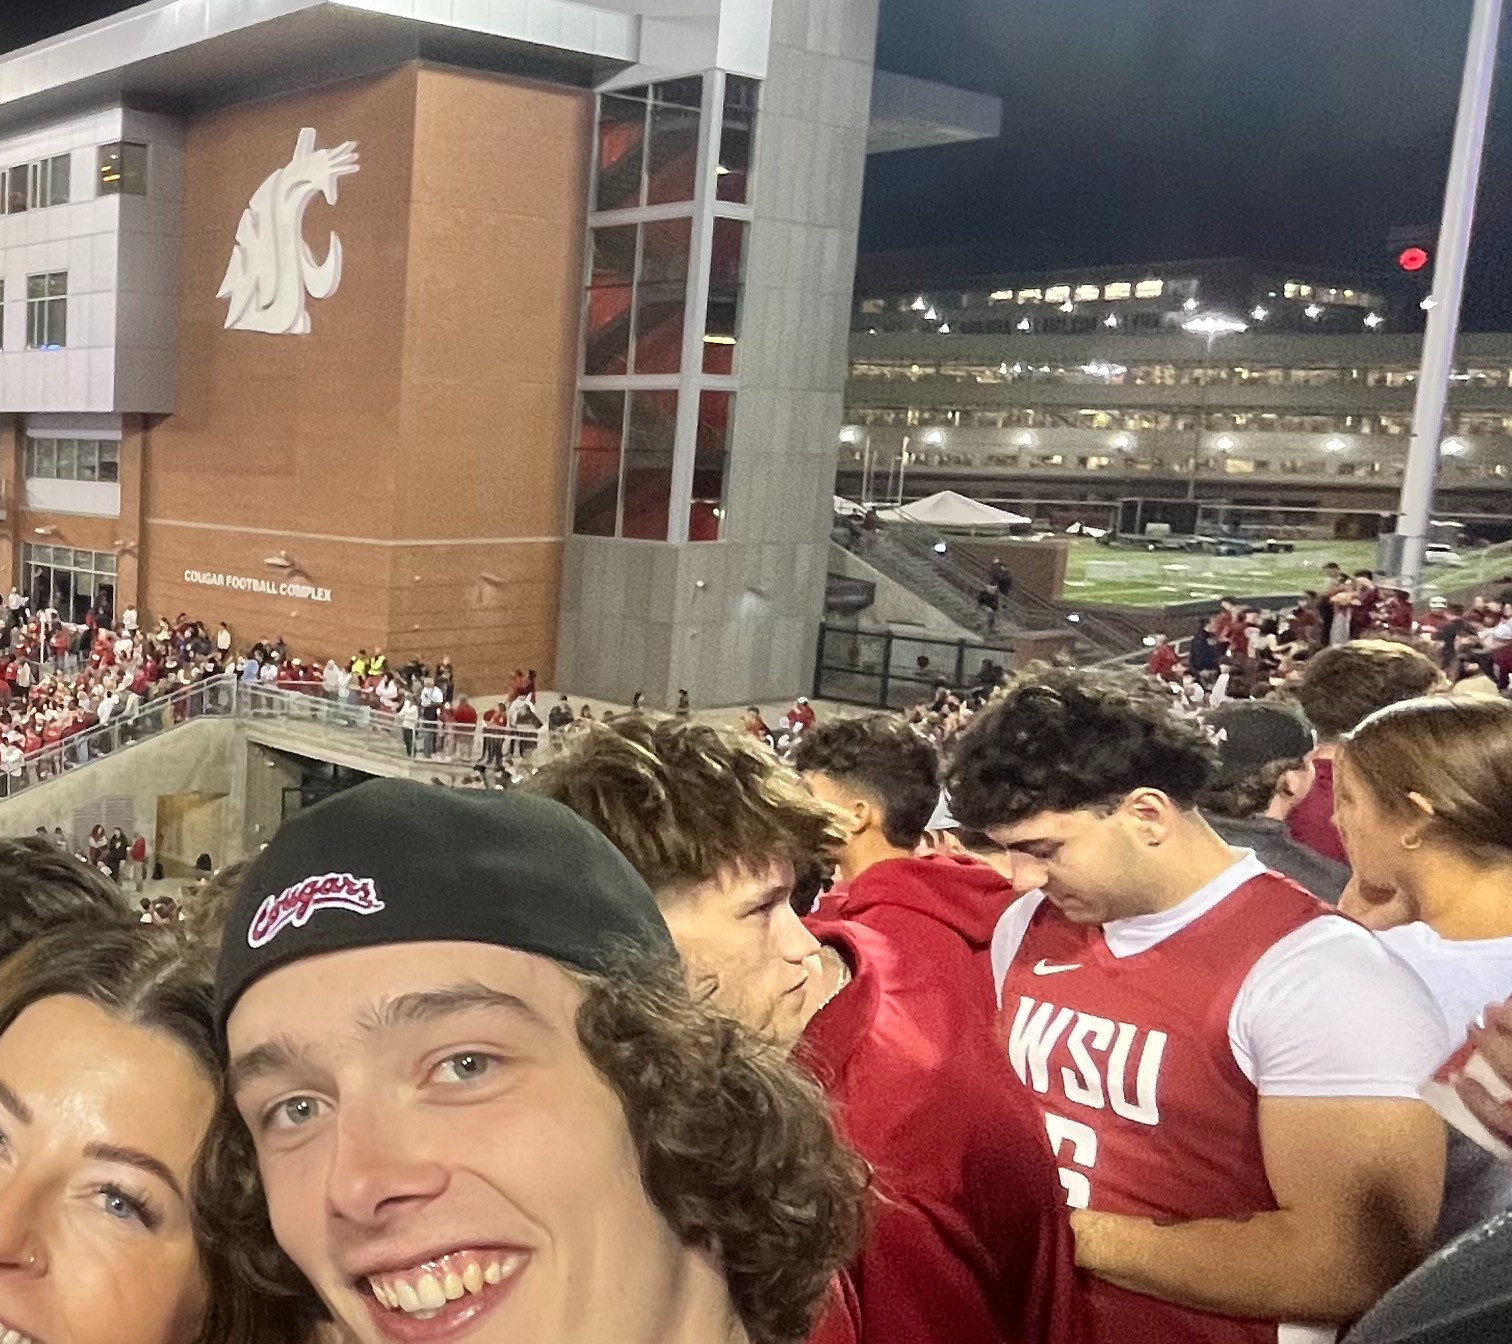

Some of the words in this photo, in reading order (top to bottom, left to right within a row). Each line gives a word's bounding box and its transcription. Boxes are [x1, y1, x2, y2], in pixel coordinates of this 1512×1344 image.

[184, 570, 224, 586] COUGAR
[226, 574, 278, 595] FOOTBALL
[279, 582, 332, 602] COMPLEX
[246, 871, 386, 949] Cougars
[1008, 995, 1168, 1126] WSU
